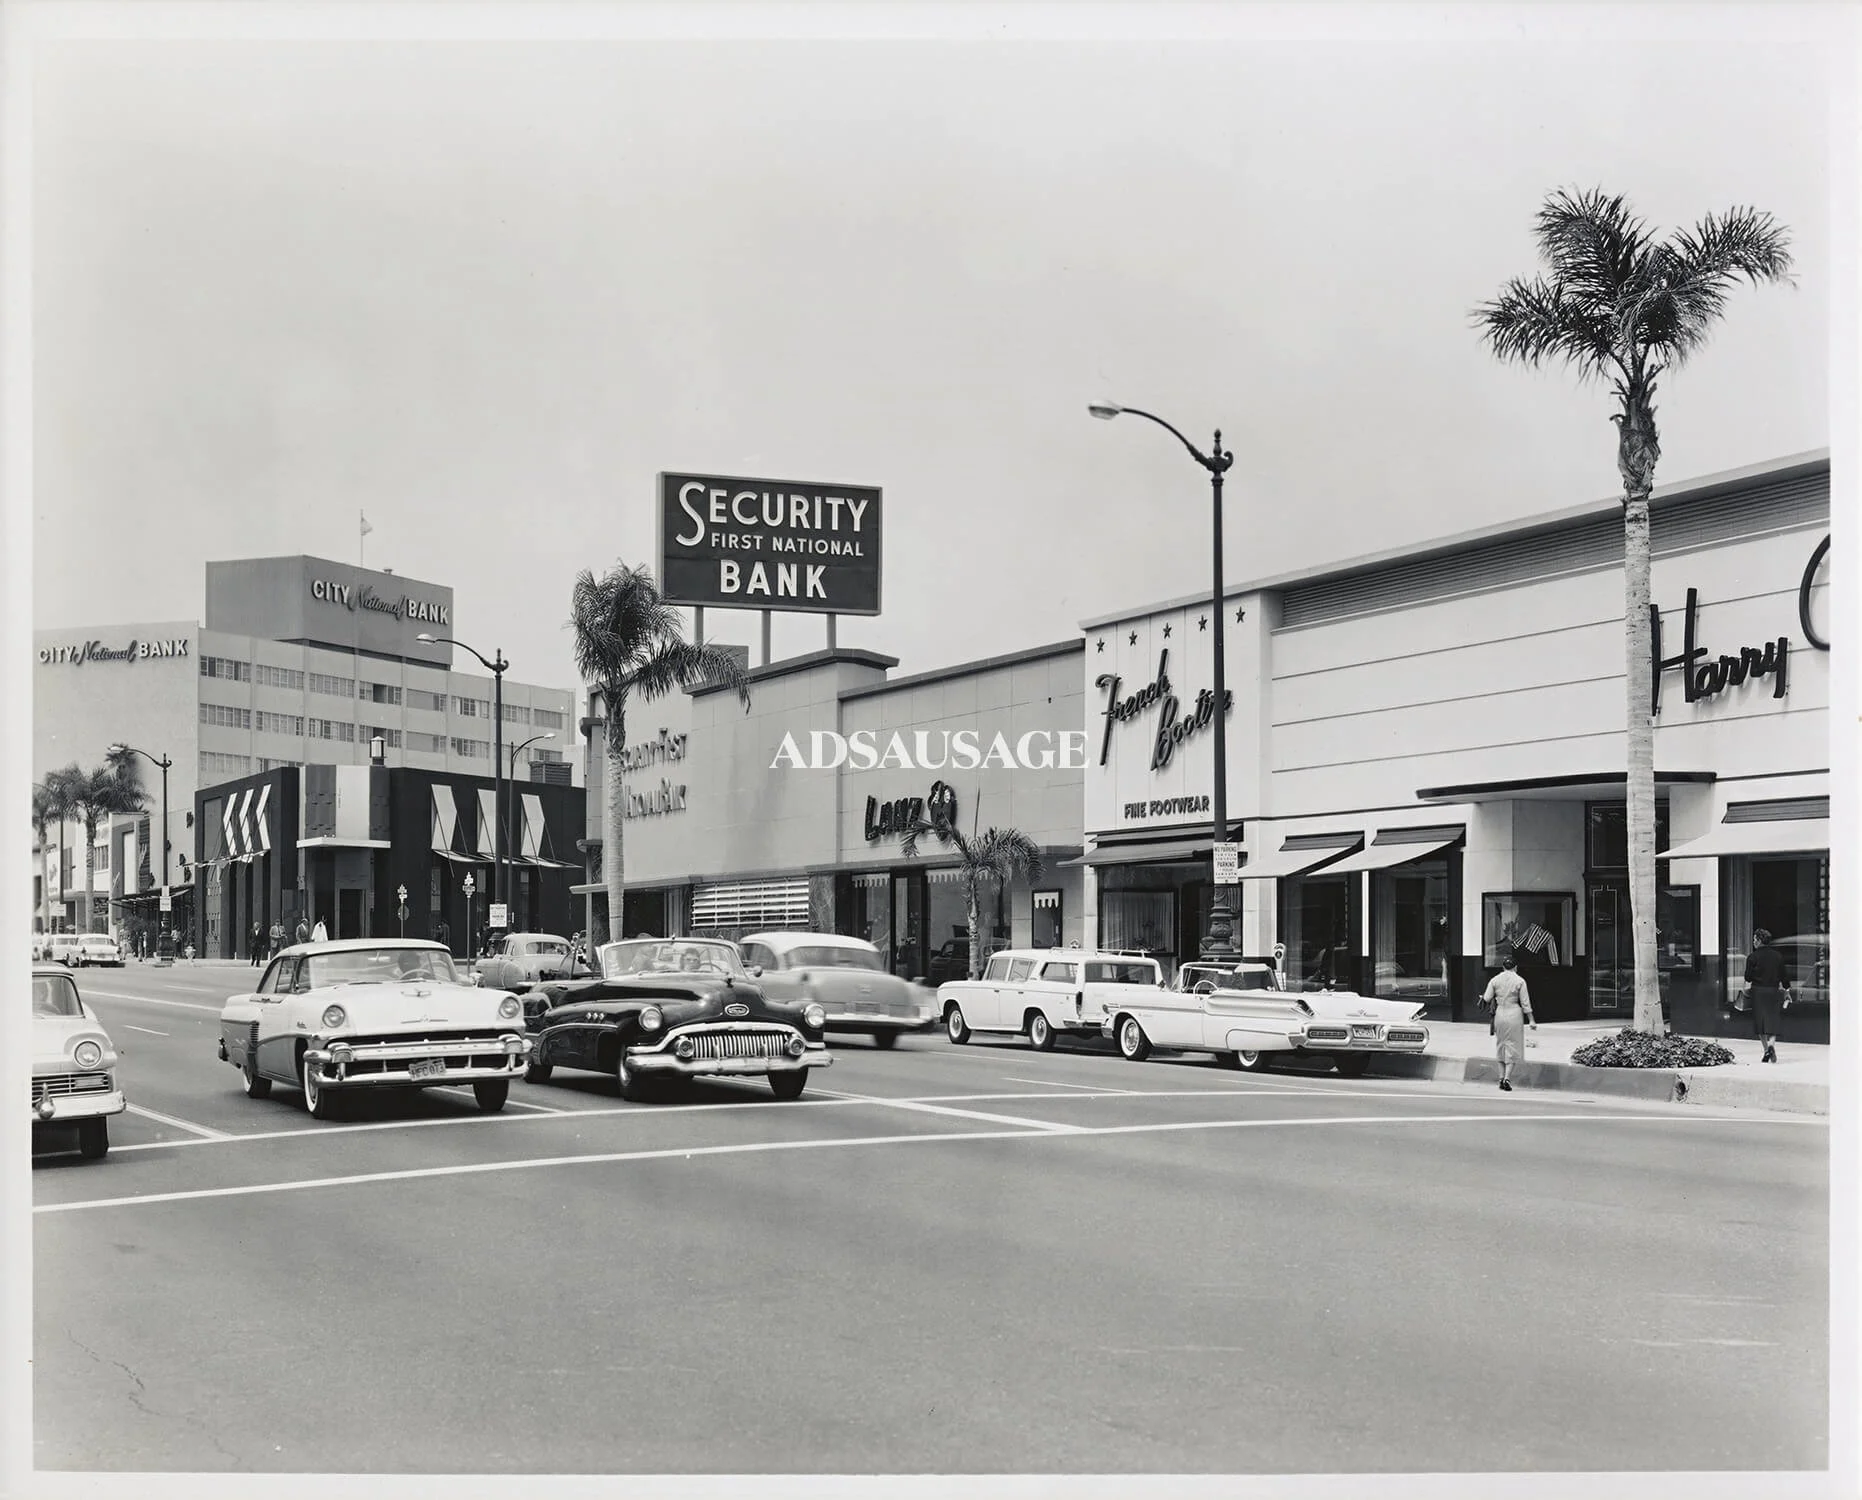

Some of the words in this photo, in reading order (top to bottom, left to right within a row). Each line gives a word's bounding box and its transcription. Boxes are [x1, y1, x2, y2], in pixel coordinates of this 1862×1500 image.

[675, 481, 869, 546] SECURITY
[711, 532, 763, 550] FIRST
[772, 536, 864, 557] NATIONAL
[720, 559, 827, 599] BANK
[311, 580, 350, 604] CITY
[347, 584, 406, 621] National
[406, 598, 449, 625] BANK
[39, 646, 76, 664] CITY
[73, 640, 138, 666] National
[139, 639, 188, 660] BANK
[1650, 587, 1788, 716] Harry
[1095, 648, 1172, 766] French
[1124, 801, 1147, 820] FINE
[1150, 795, 1210, 817] FOOTWEAR
